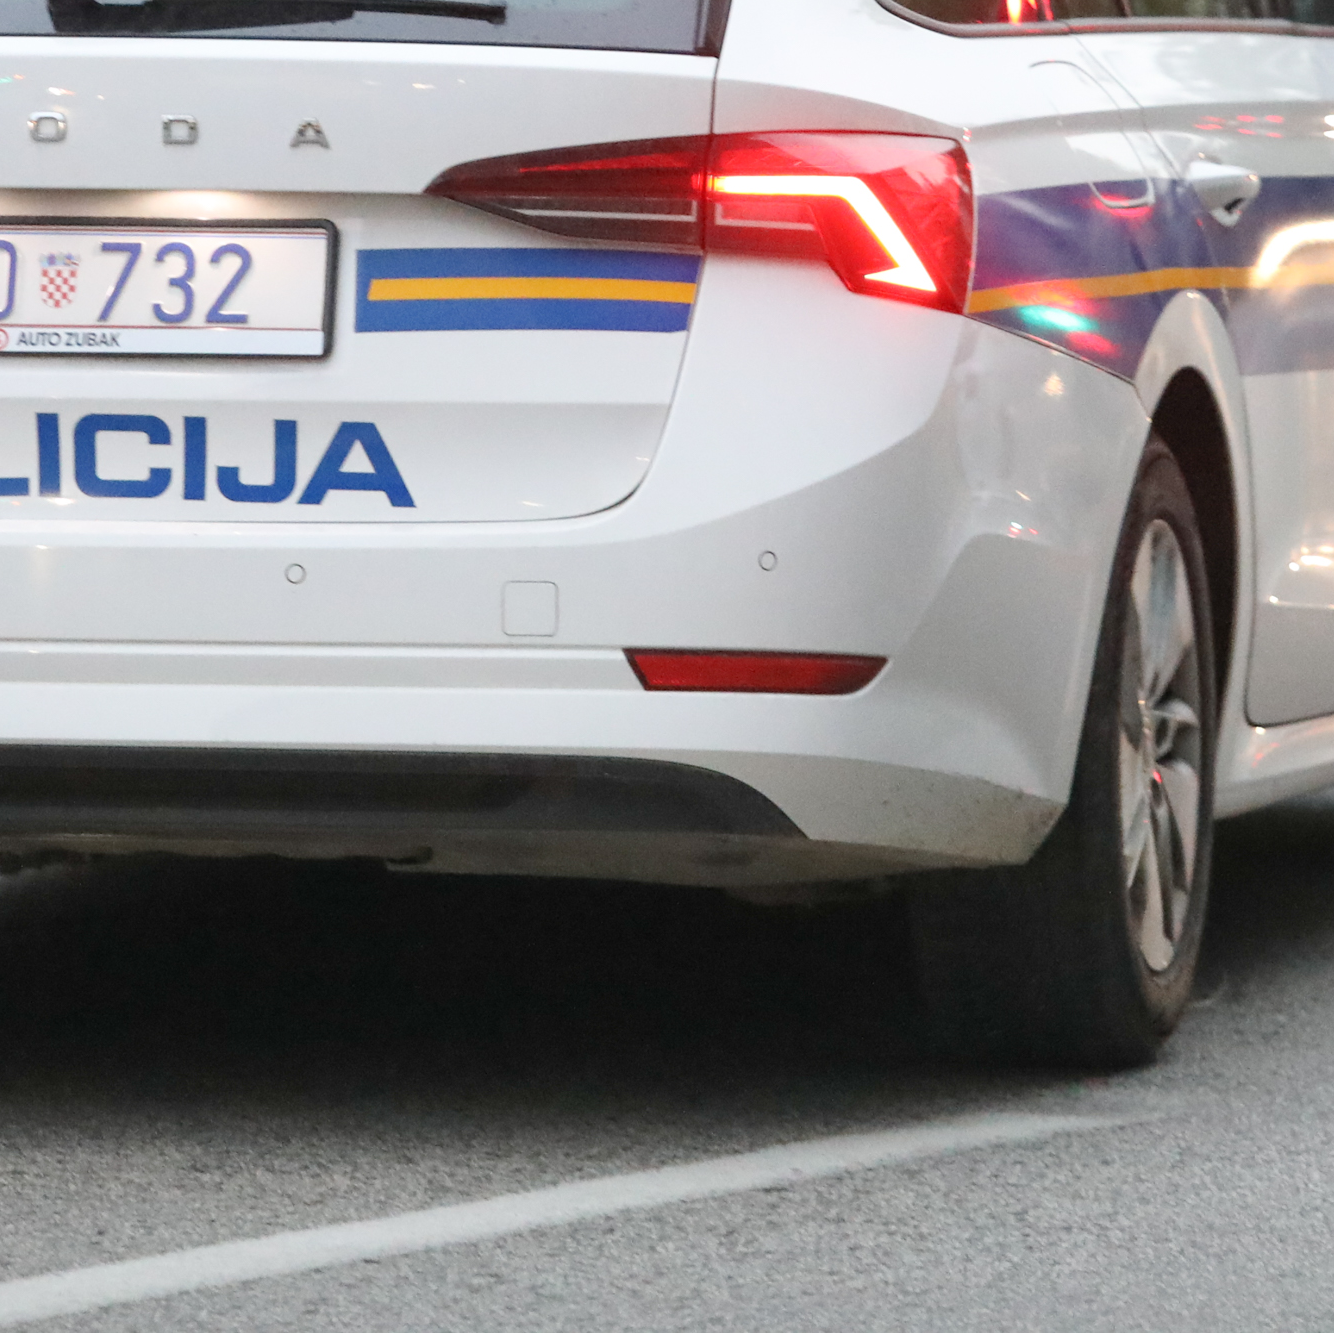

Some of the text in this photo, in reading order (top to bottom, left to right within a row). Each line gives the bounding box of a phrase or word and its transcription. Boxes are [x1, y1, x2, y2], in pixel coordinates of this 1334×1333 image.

[98, 241, 253, 324] 732
[18, 332, 120, 348] AUTO ZUBAK
